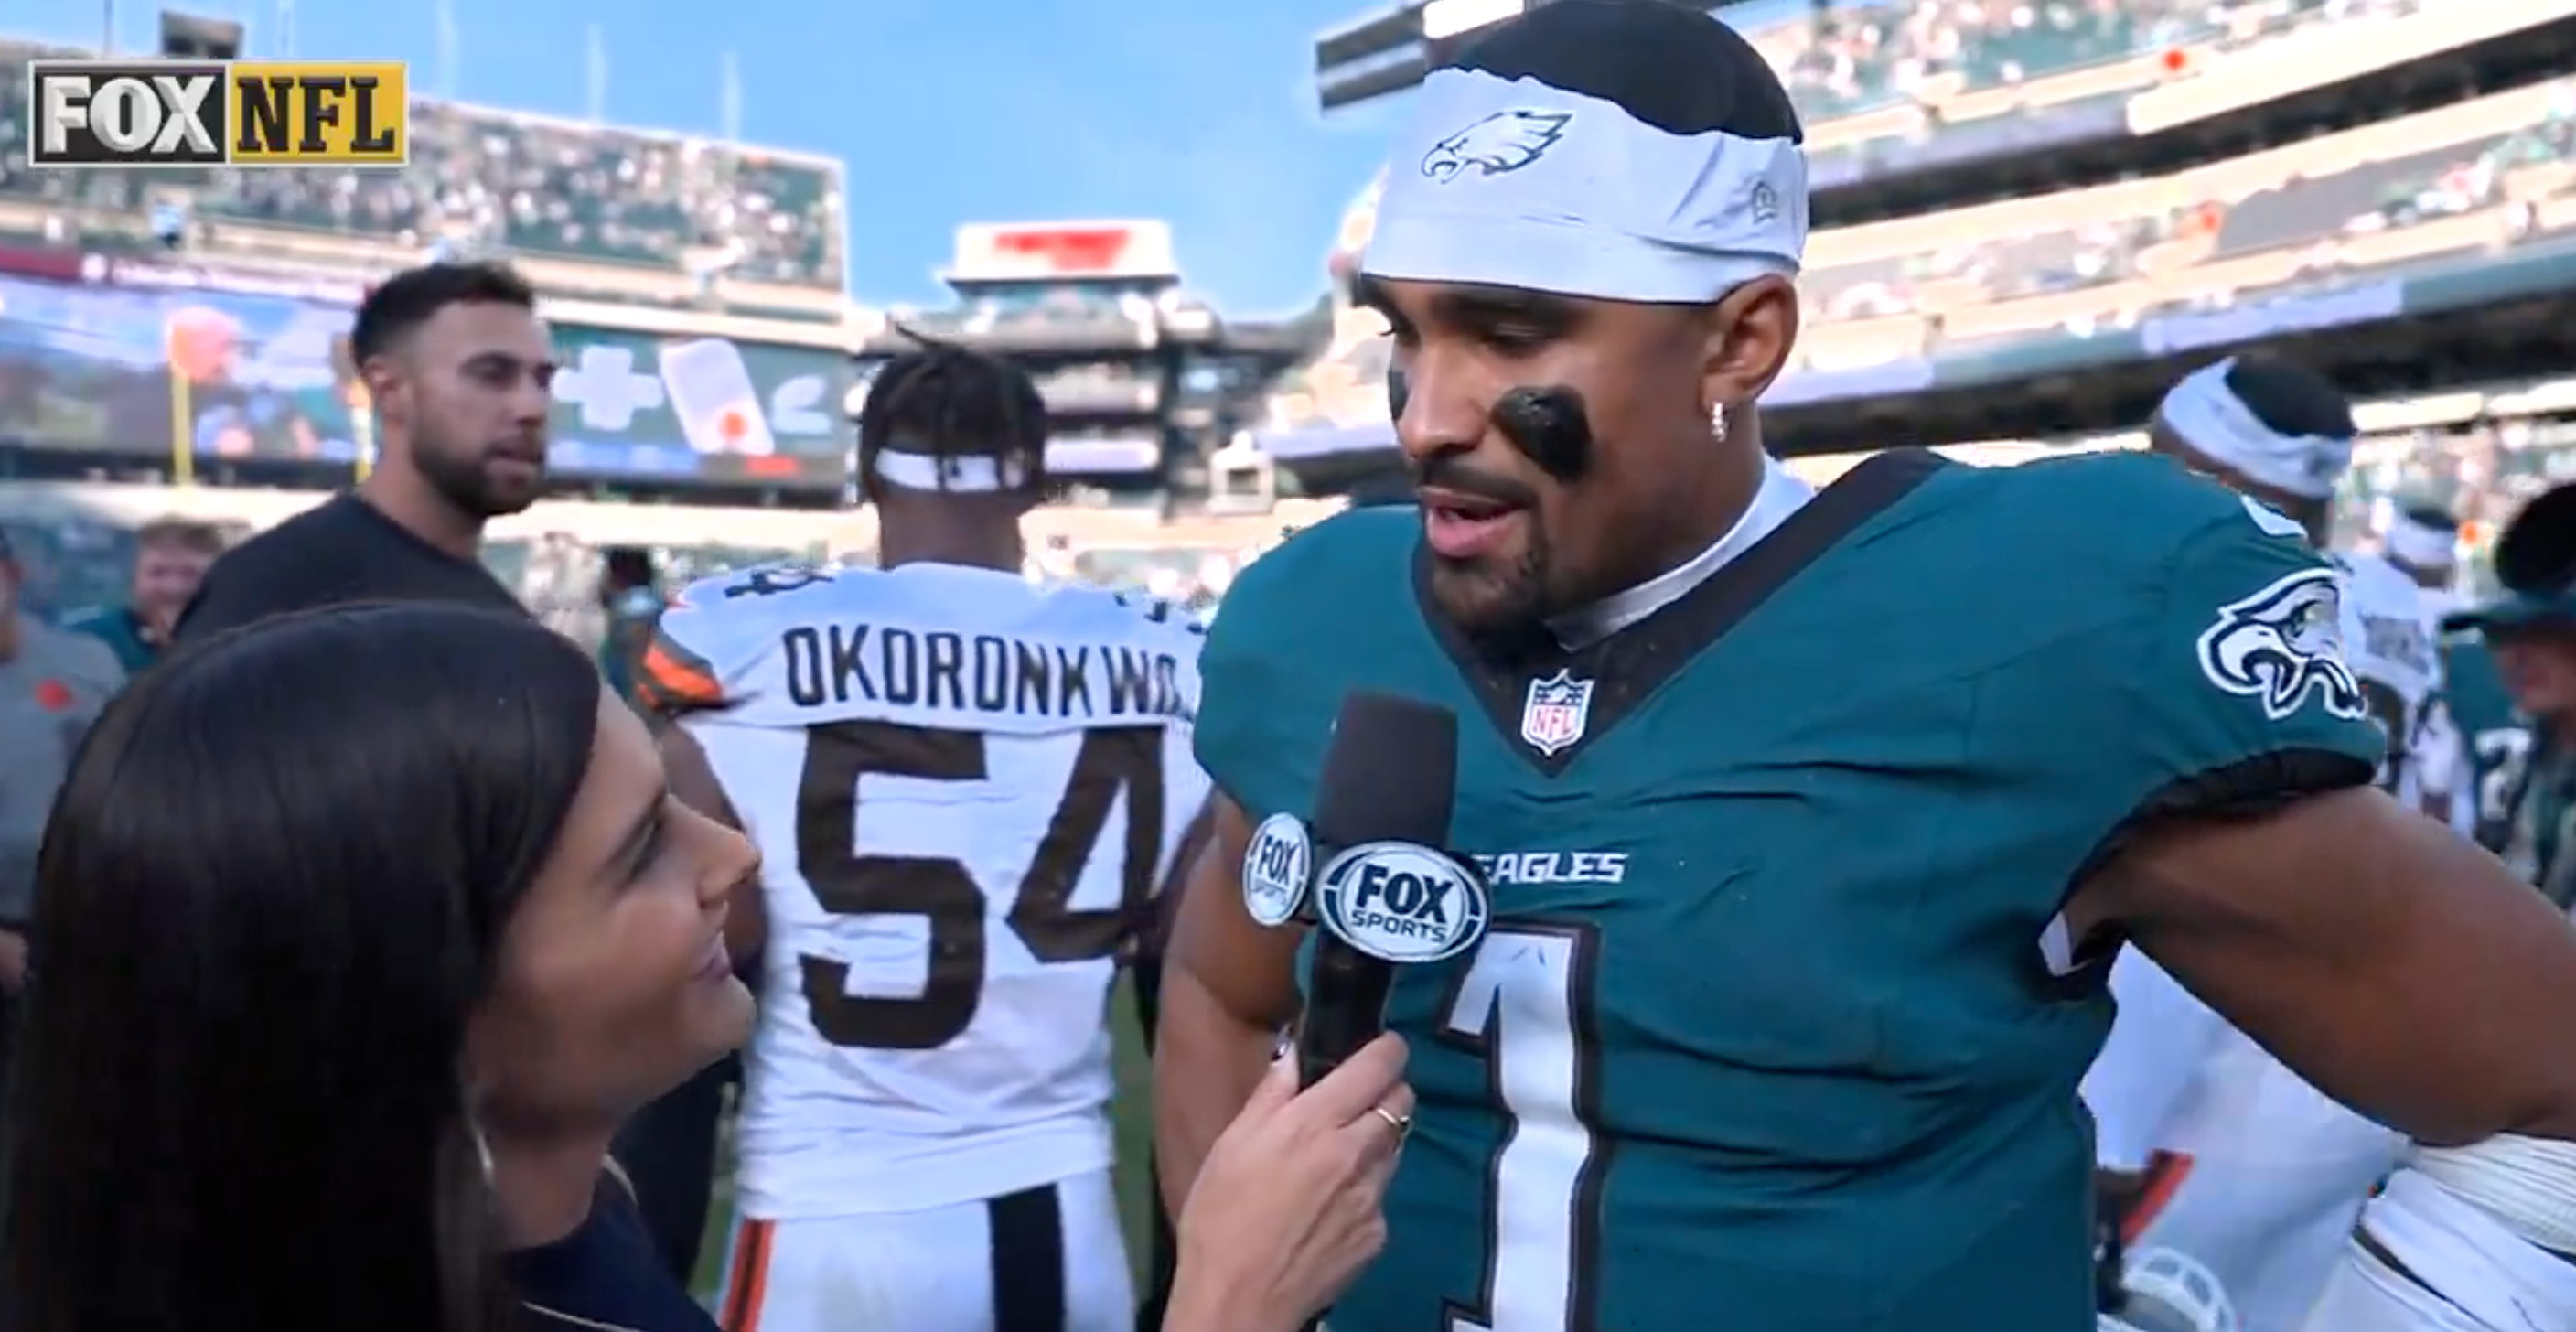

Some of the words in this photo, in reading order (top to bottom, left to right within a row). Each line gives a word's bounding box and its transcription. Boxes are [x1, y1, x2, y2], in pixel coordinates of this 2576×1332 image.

[1531, 707, 1574, 739] NFL
[796, 718, 1167, 1049] 54
[1257, 834, 1302, 886] FOX
[1355, 863, 1454, 925] FOX
[1351, 909, 1449, 943] SPORTS
[1437, 922, 1605, 1332] 1
